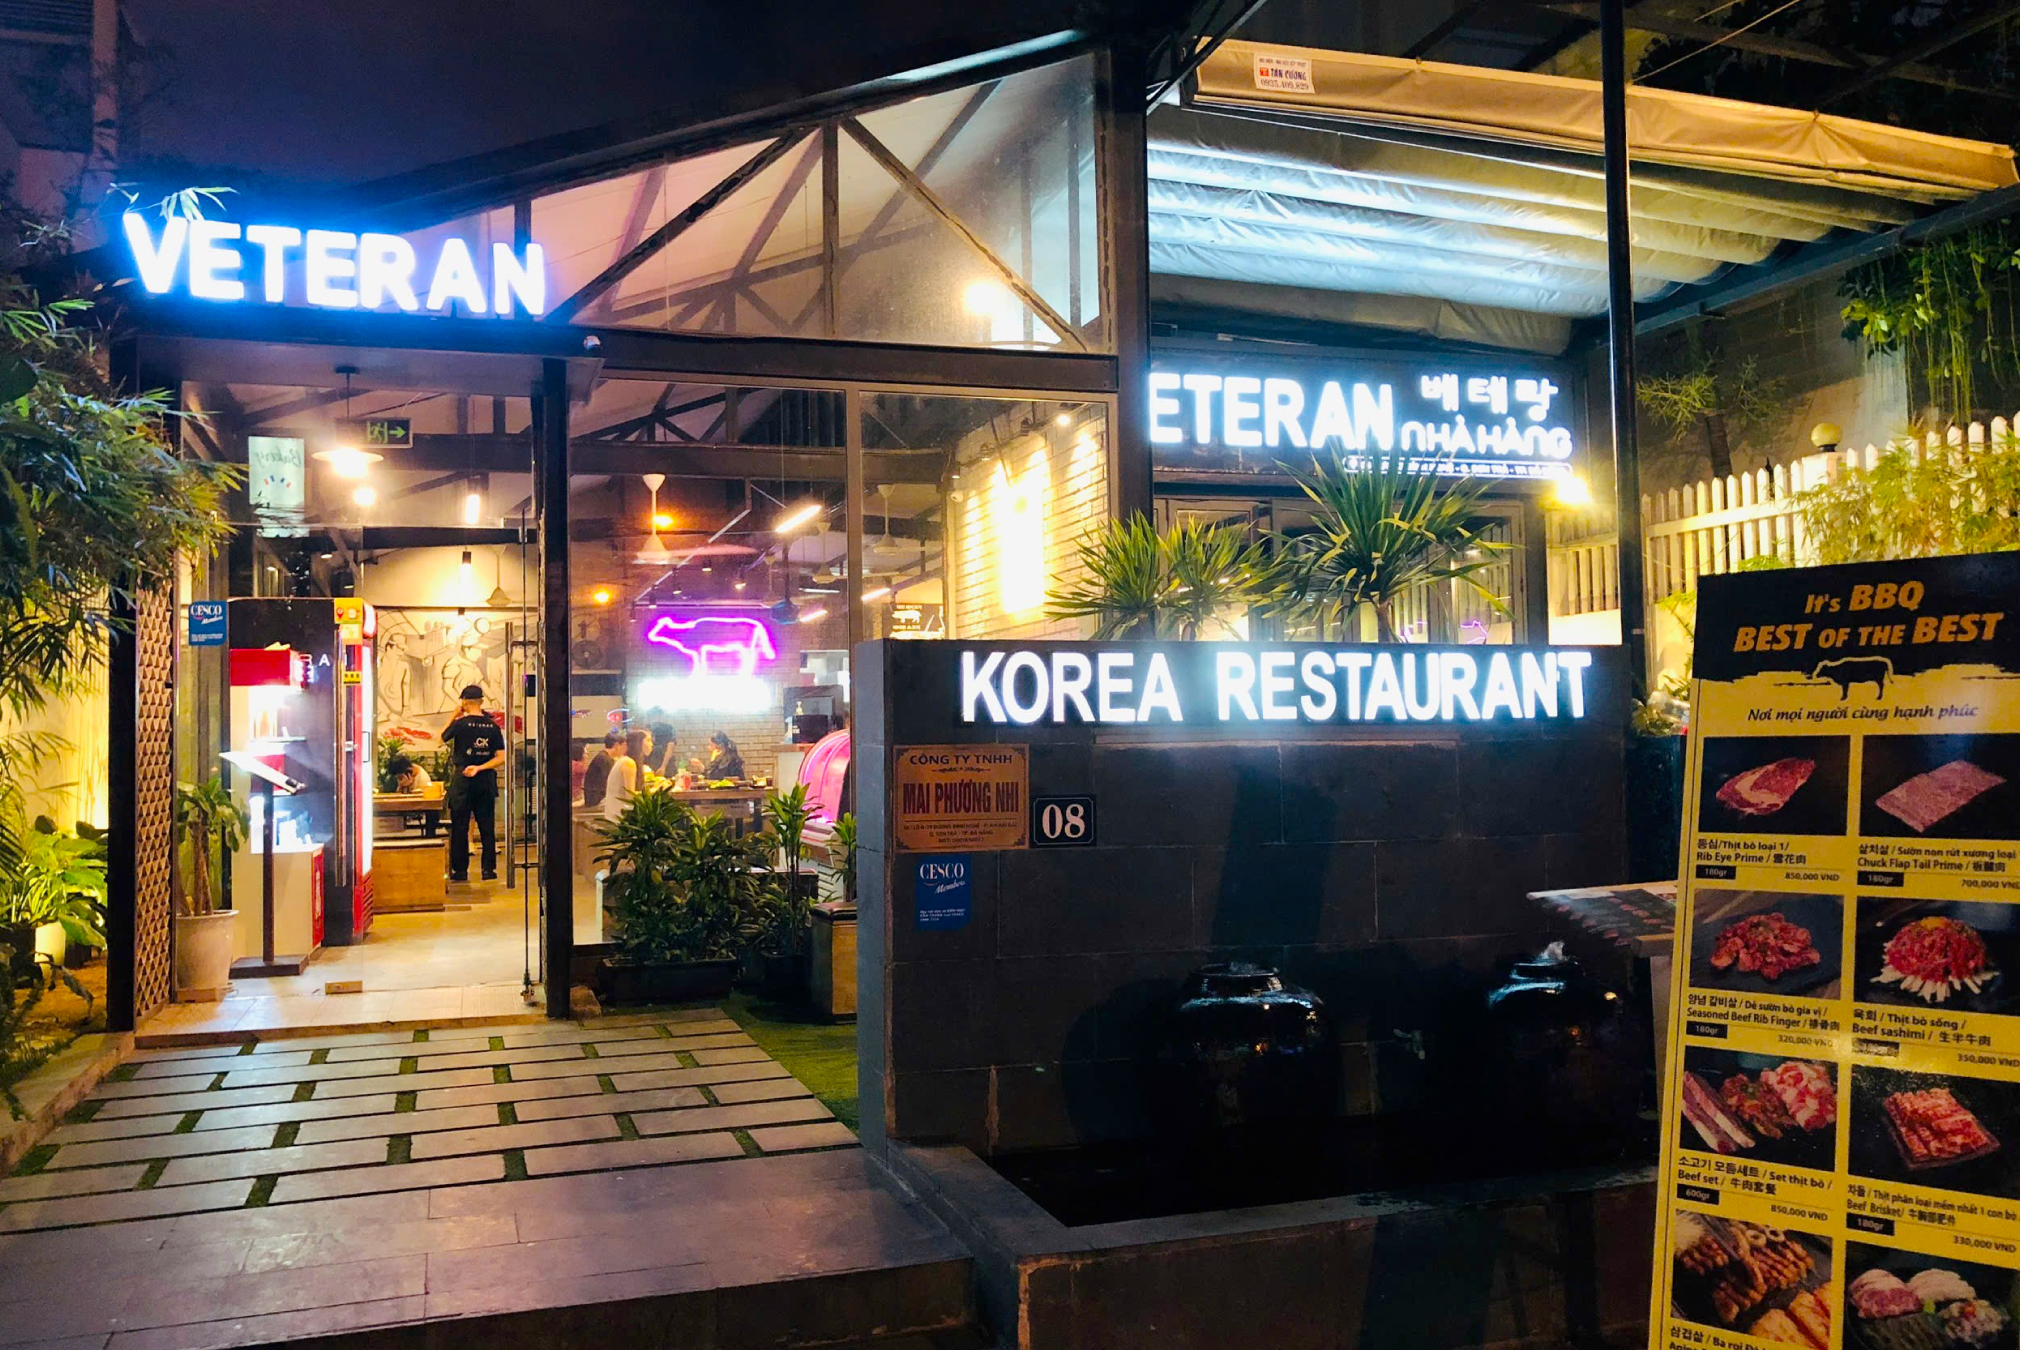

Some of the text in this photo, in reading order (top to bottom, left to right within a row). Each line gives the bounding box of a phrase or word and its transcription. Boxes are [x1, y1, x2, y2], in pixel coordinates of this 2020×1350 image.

[122, 212, 546, 315] VETERAN
[1148, 372, 1395, 451] ETERAN
[1804, 580, 1925, 614] It's BBQ
[190, 604, 222, 616] CESCO
[1733, 612, 2004, 652] BEST OF THE BEST
[961, 651, 1593, 723] KOREA RESTAURANT
[910, 753, 1013, 765] CÔNG TY TNHH
[903, 782, 931, 814] MAI
[995, 781, 1019, 812] NHI
[1042, 803, 1086, 839] 08
[1696, 852, 1712, 861] Rib
[1715, 852, 1731, 863] Eye
[1734, 852, 1764, 862] Prime
[1857, 857, 1887, 867] Chuck
[1889, 858, 1910, 870] Flap
[1912, 859, 1931, 869] Tail
[1934, 860, 1963, 870] Prime
[919, 863, 965, 879] CESCO
[1820, 873, 1840, 881] VND
[1687, 1007, 1729, 1020] Seasoned
[1731, 1010, 1752, 1022] Beef
[1753, 1013, 1769, 1023] Rib
[1770, 1016, 1801, 1029] Finger
[1852, 1022, 1878, 1035] Beef
[1881, 1025, 1925, 1040] sashimi
[1678, 1155, 1711, 1170] 소고기
[1769, 1171, 1787, 1182] Set
[1678, 1169, 1700, 1182] Beef
[1703, 1173, 1718, 1184] set
[1847, 1199, 1867, 1212] Beef
[1808, 1211, 1828, 1222] VND
